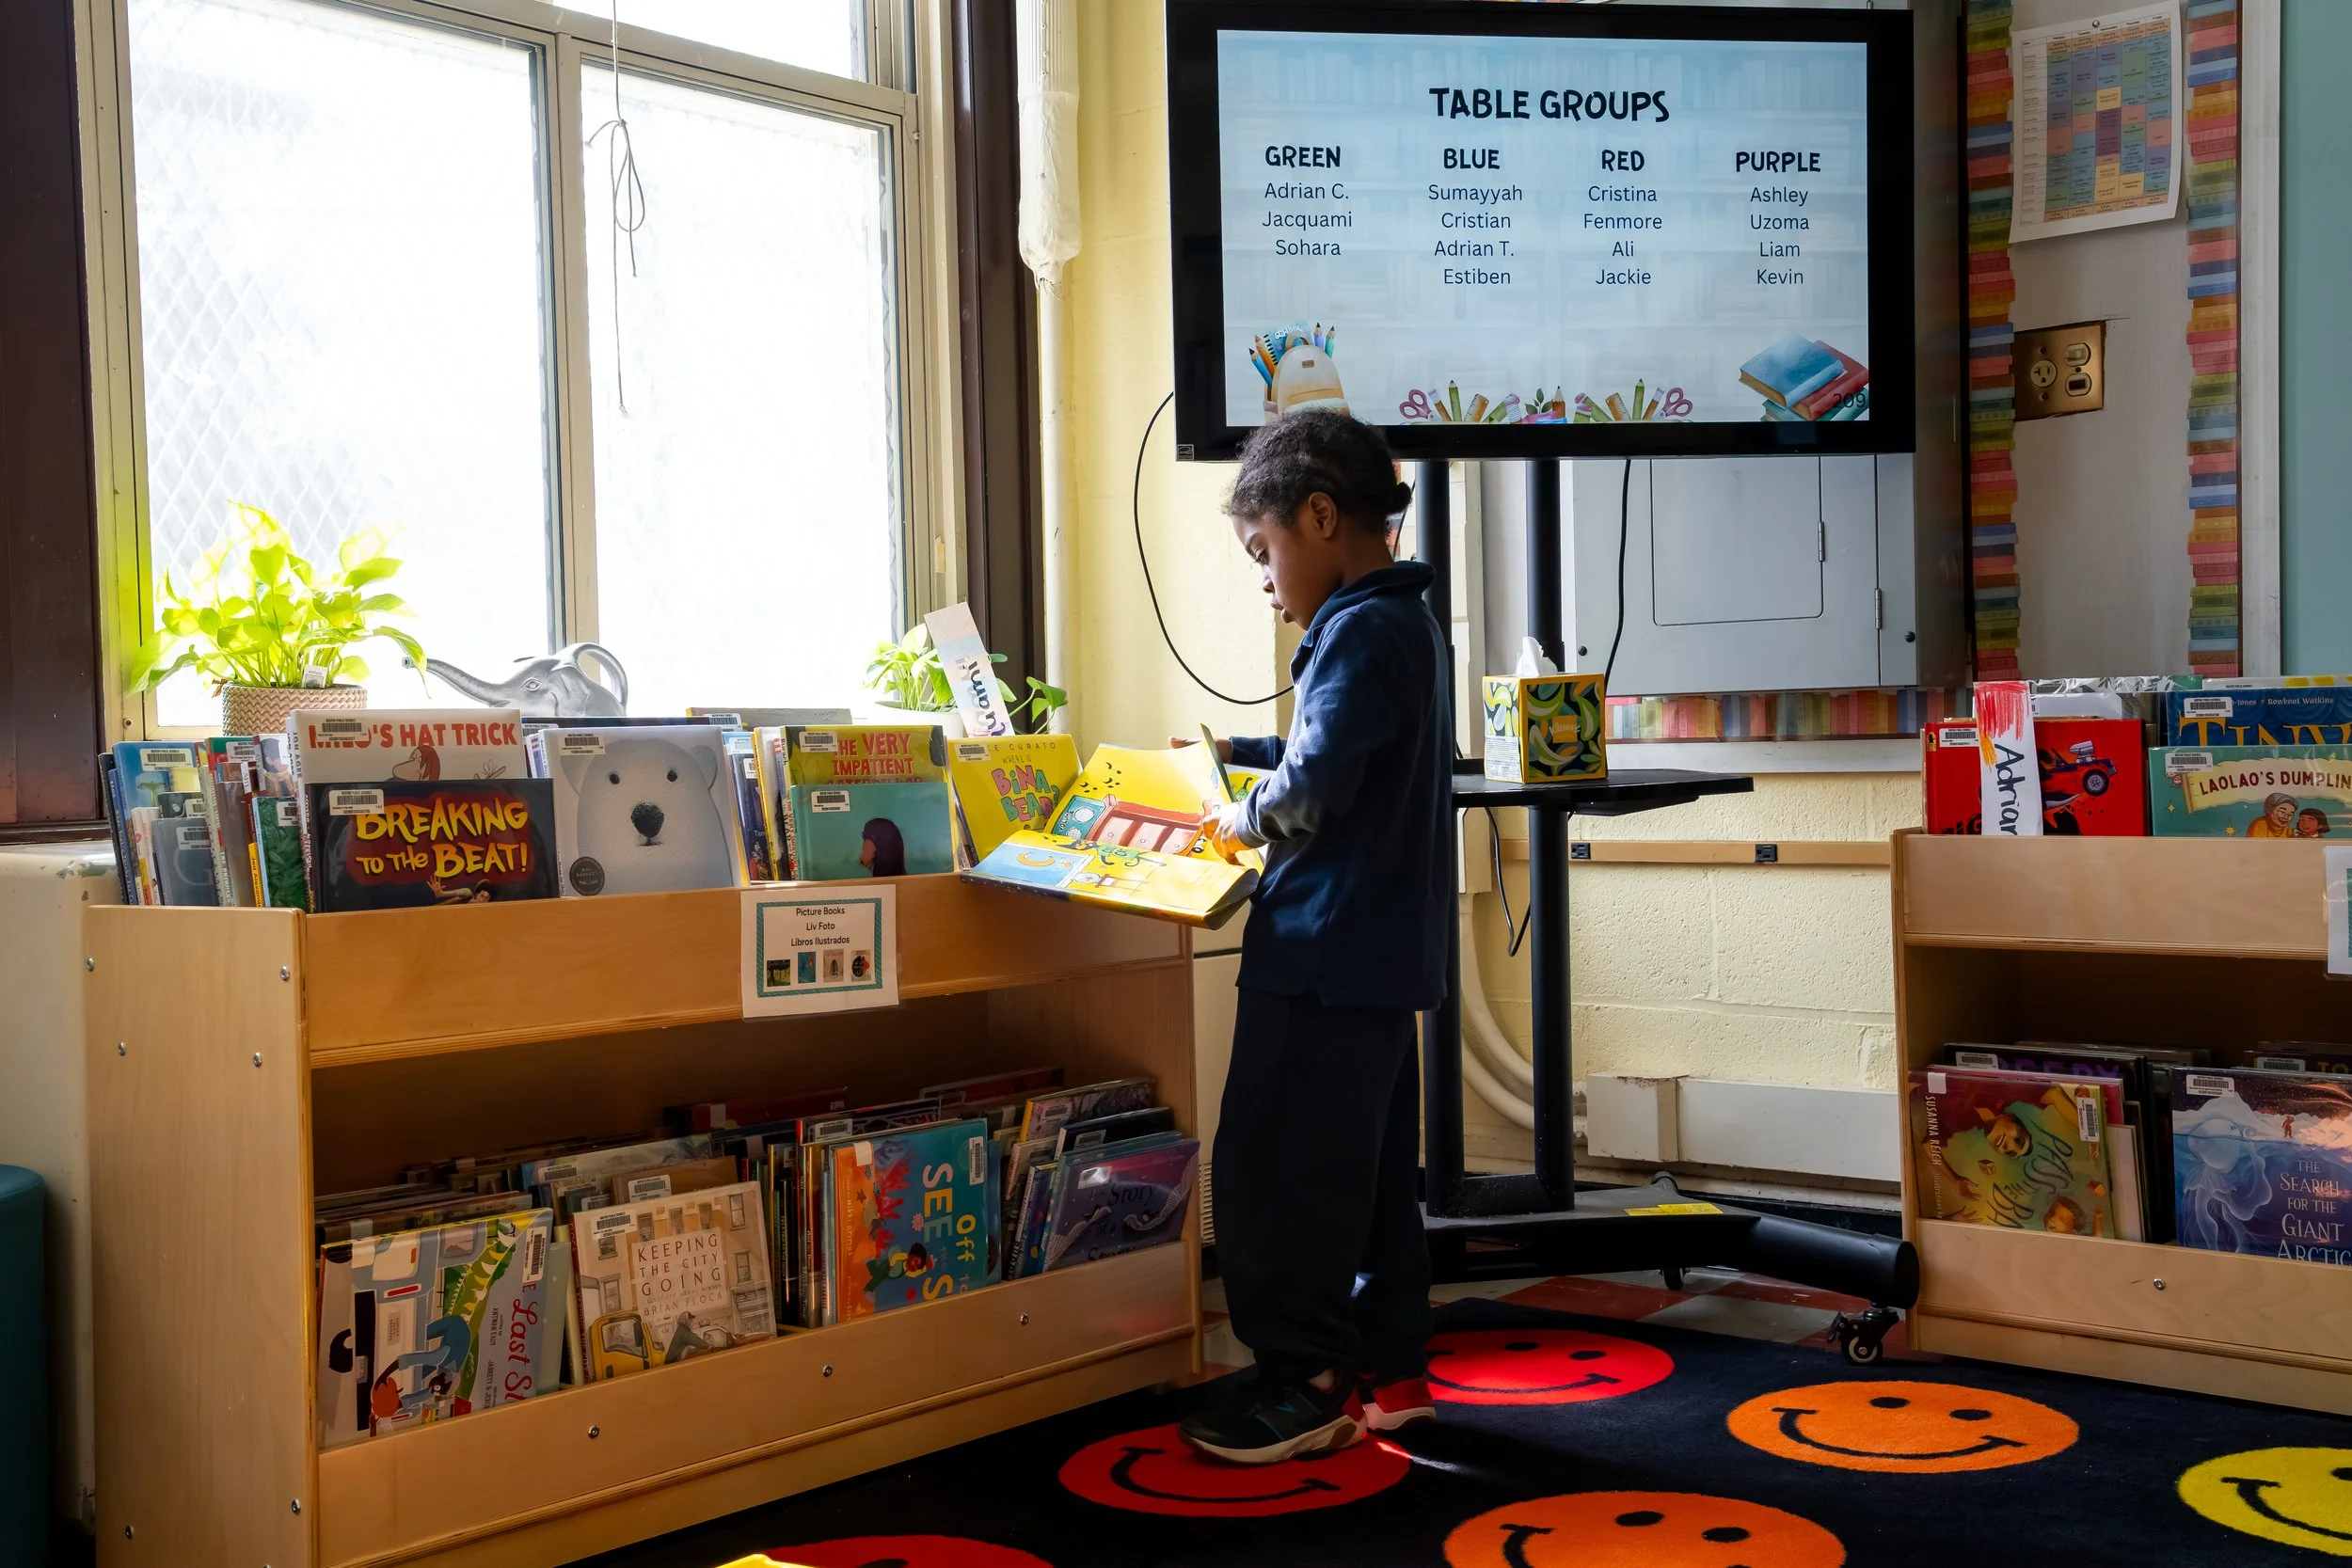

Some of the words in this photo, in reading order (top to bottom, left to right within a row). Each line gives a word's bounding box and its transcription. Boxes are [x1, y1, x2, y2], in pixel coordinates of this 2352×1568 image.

[1429, 87, 1530, 119] TABLE
[1540, 89, 1669, 122] GROUPS
[1265, 146, 1341, 168] GREEN
[1443, 148, 1500, 169] BLUE
[1601, 149, 1645, 172] RED
[1736, 151, 1821, 173] PURPLE
[1264, 182, 1326, 199] Adrian
[1331, 183, 1349, 199] C.
[1428, 184, 1523, 205] Sumayyah
[1588, 186, 1657, 202] Cristina
[1750, 187, 1809, 206] Ashley
[1262, 211, 1352, 231] Jacquami
[1441, 213, 1511, 229] Cristian
[1583, 214, 1663, 230] Fenmore
[1750, 214, 1810, 230] Uzoma
[1275, 239, 1342, 256] Sohara
[1434, 240, 1494, 257] Adrian
[1498, 241, 1515, 257] T.
[1612, 241, 1635, 257] Ali
[1759, 242, 1801, 257] Liam
[1444, 269, 1511, 285] Estiben
[1596, 269, 1652, 285] Jackie
[1756, 269, 1804, 285] Kevin
[1833, 392, 1867, 409] 209
[399, 724, 446, 747] HAT
[451, 722, 518, 746] TRICK
[861, 733, 911, 757] VERY
[1009, 742, 1056, 751] CURATO
[832, 758, 914, 776] IMPATIENT
[1002, 756, 1024, 764] WHERE
[1026, 754, 1032, 763] IS
[2200, 771, 2275, 796] LAOLAO'S
[356, 798, 529, 843] BREAKING
[356, 856, 384, 874] TO
[431, 842, 528, 878] BEAT!
[796, 908, 822, 916] Picture
[823, 906, 845, 915] Books
[806, 922, 817, 931] Liv
[818, 921, 835, 930] Foto
[791, 937, 813, 947] Libros
[815, 935, 850, 945] Ilustrados
[1925, 1096, 1939, 1136] SUSANNA
[1929, 1140, 1943, 1166] REICH
[2296, 1159, 2320, 1174] THE
[2280, 1172, 2339, 1196] SEARCH
[922, 1163, 954, 1243] SEE
[1110, 1184, 1155, 1207] Story
[2287, 1197, 2309, 1212] FOR
[2312, 1199, 2336, 1214] THE
[2281, 1213, 2344, 1242] GIANT
[637, 1233, 717, 1262] KEEPING
[640, 1262, 670, 1278] THE
[682, 1252, 718, 1269] CITY
[641, 1267, 721, 1296] GOING
[644, 1300, 678, 1316] BRIAN
[686, 1291, 723, 1307] FLOCA
[504, 1298, 538, 1367] Last
